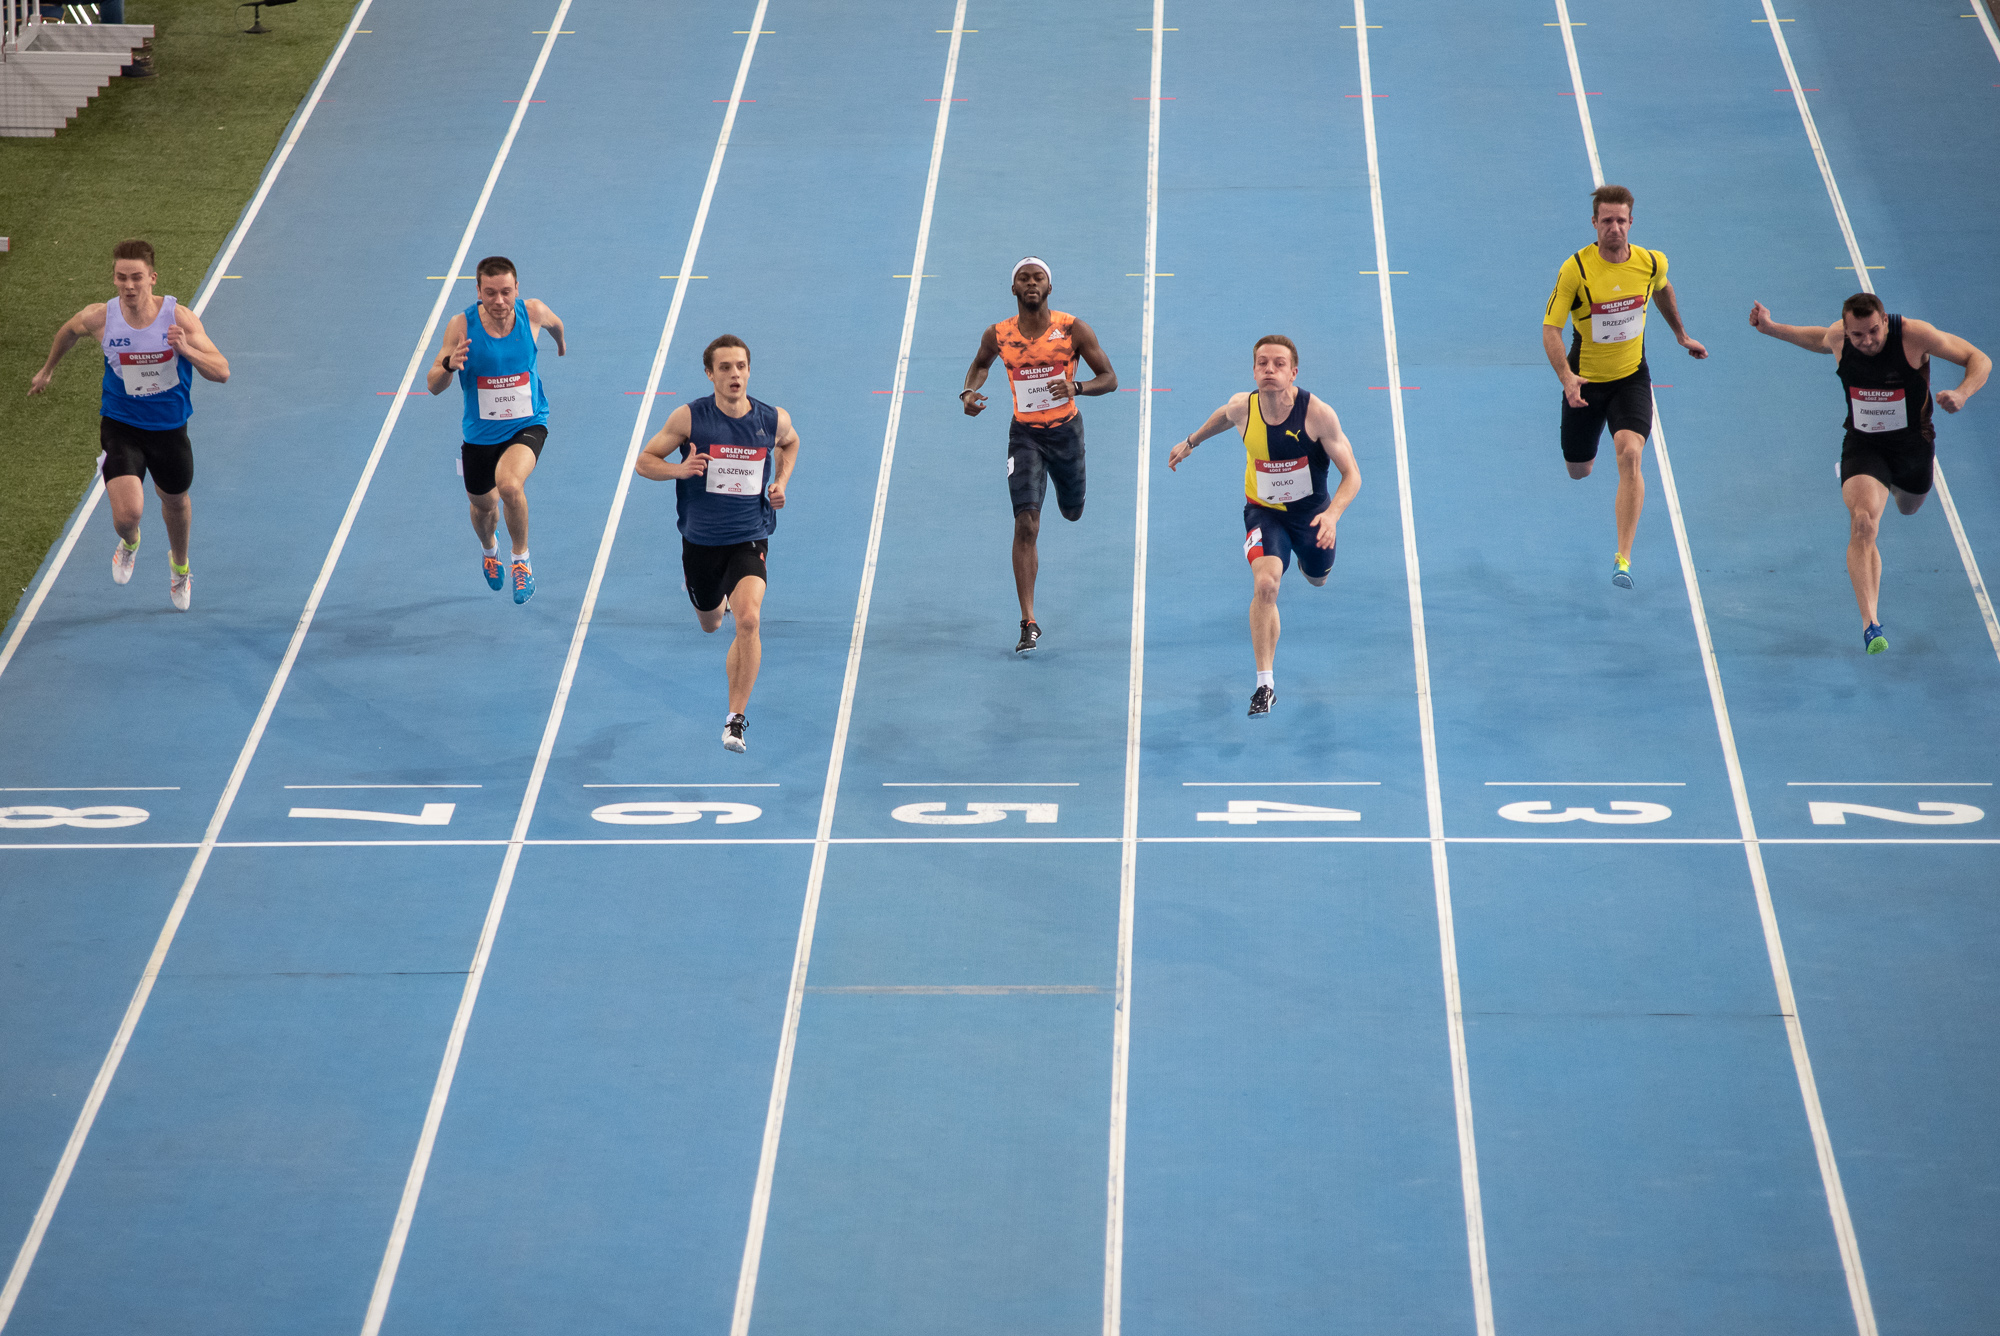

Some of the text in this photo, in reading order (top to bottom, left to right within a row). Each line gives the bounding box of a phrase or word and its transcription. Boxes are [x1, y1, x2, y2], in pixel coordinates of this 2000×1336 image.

[1601, 302, 1622, 310] ORLEN
[109, 338, 131, 347] AZS
[1028, 386, 1050, 394] CARNE
[718, 468, 754, 476] OLSZEWSKI
[0, 805, 150, 829] 8
[287, 802, 457, 826] 7
[590, 801, 763, 825] 6
[891, 801, 1060, 825] 5
[1196, 800, 1362, 825] 4
[1497, 800, 1673, 825] 3
[1807, 801, 1985, 825] 2
